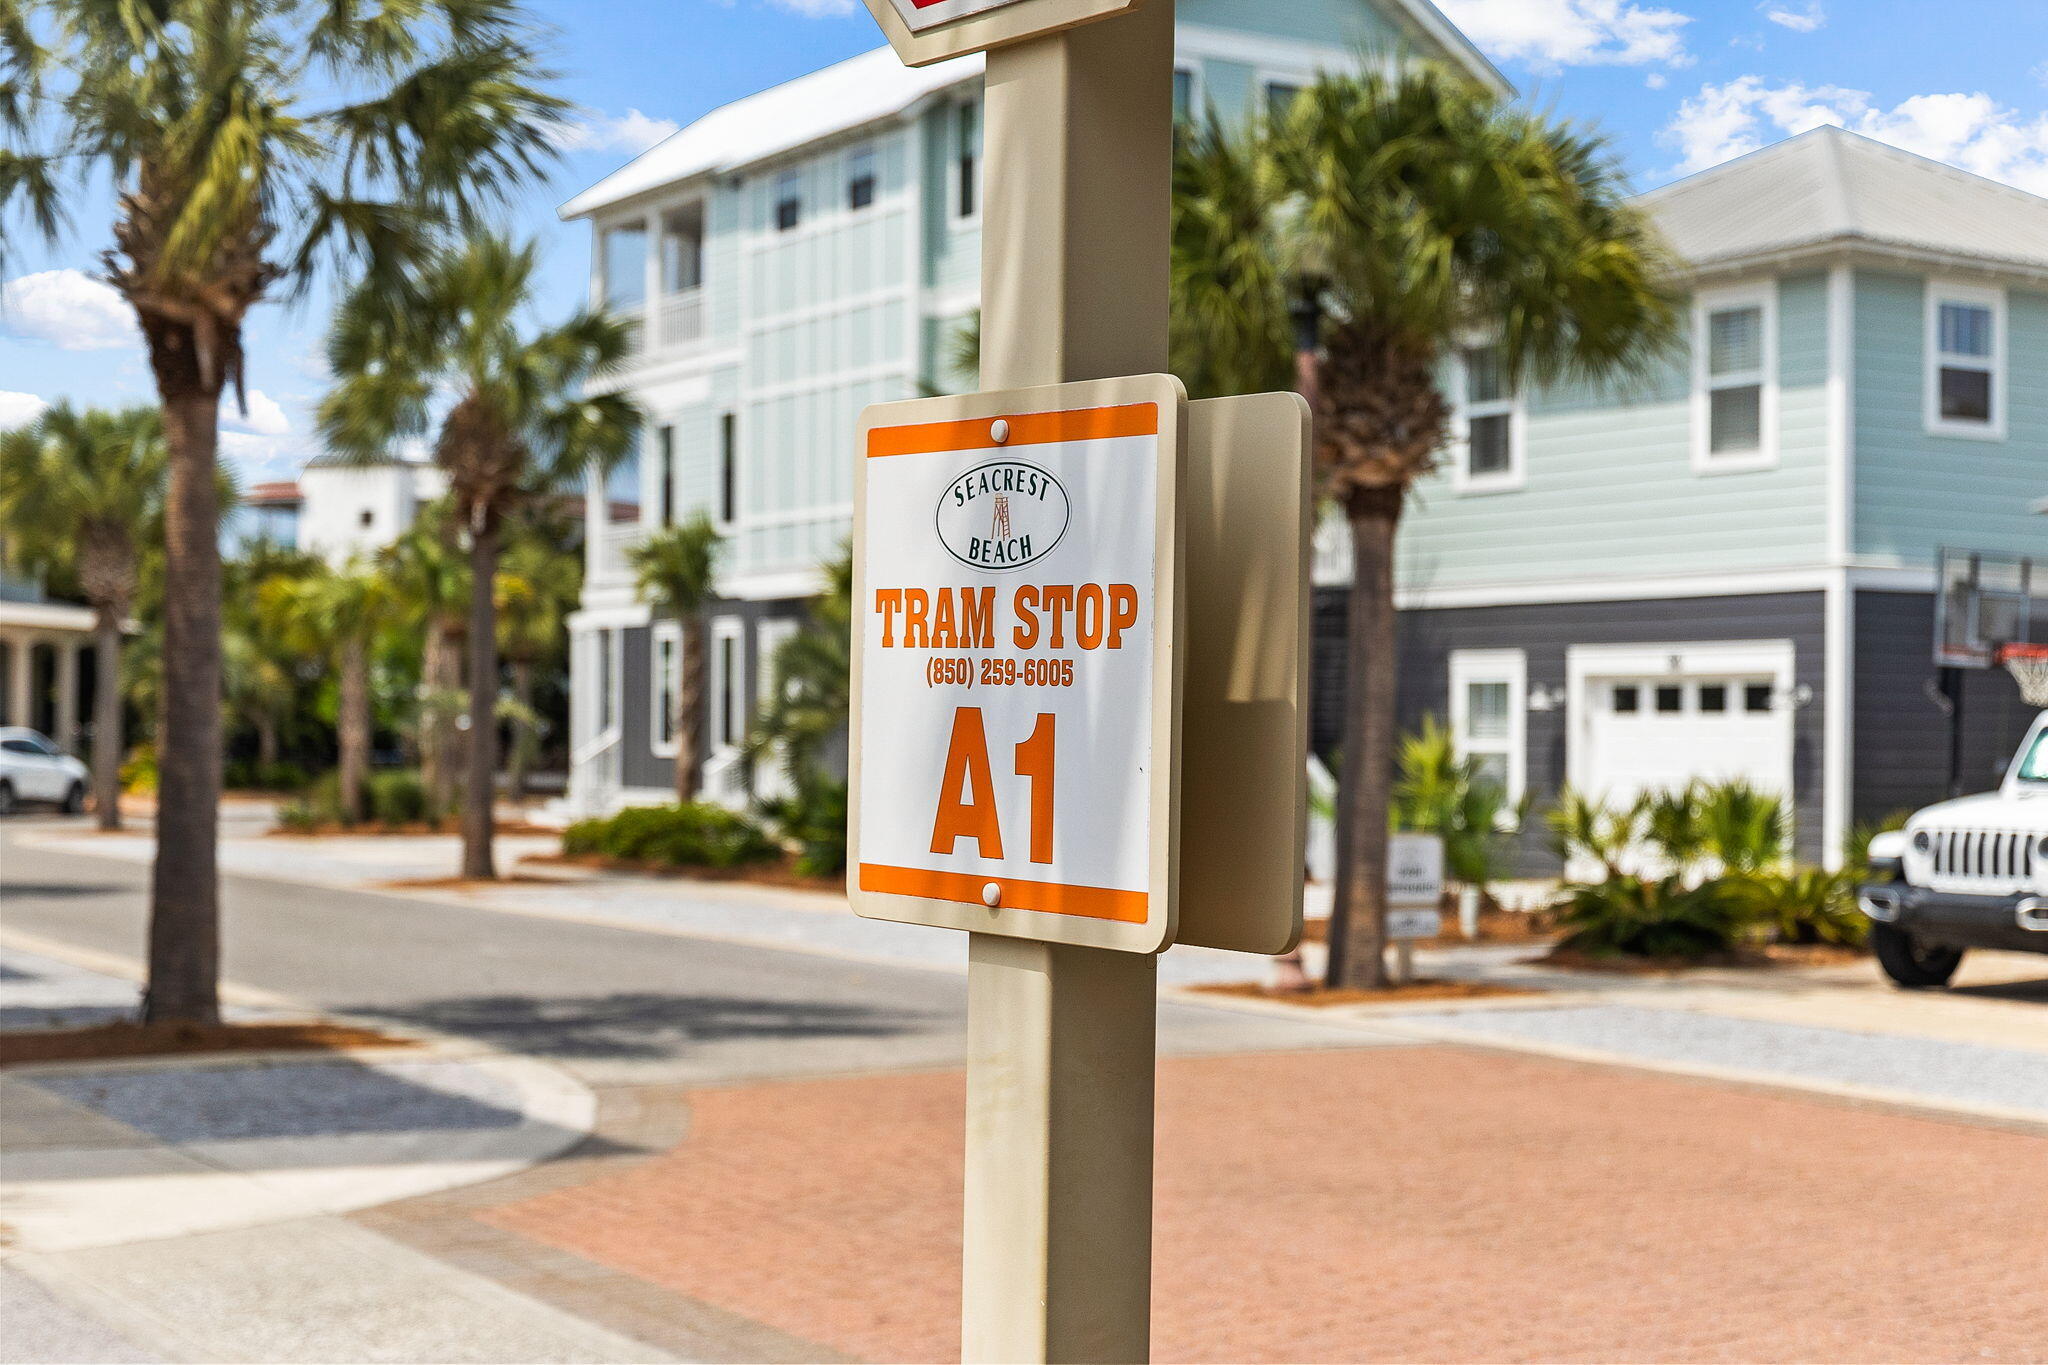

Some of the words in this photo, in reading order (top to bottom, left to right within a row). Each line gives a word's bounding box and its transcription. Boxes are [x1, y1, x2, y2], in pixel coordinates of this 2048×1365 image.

[954, 468, 1050, 507] SEACREST
[969, 534, 1032, 563] BEACH
[876, 587, 996, 648] TRAM
[1013, 583, 1138, 650] STOP
[926, 657, 975, 689] (850)
[980, 658, 1074, 687] 259-6005
[929, 706, 1057, 865] A1
